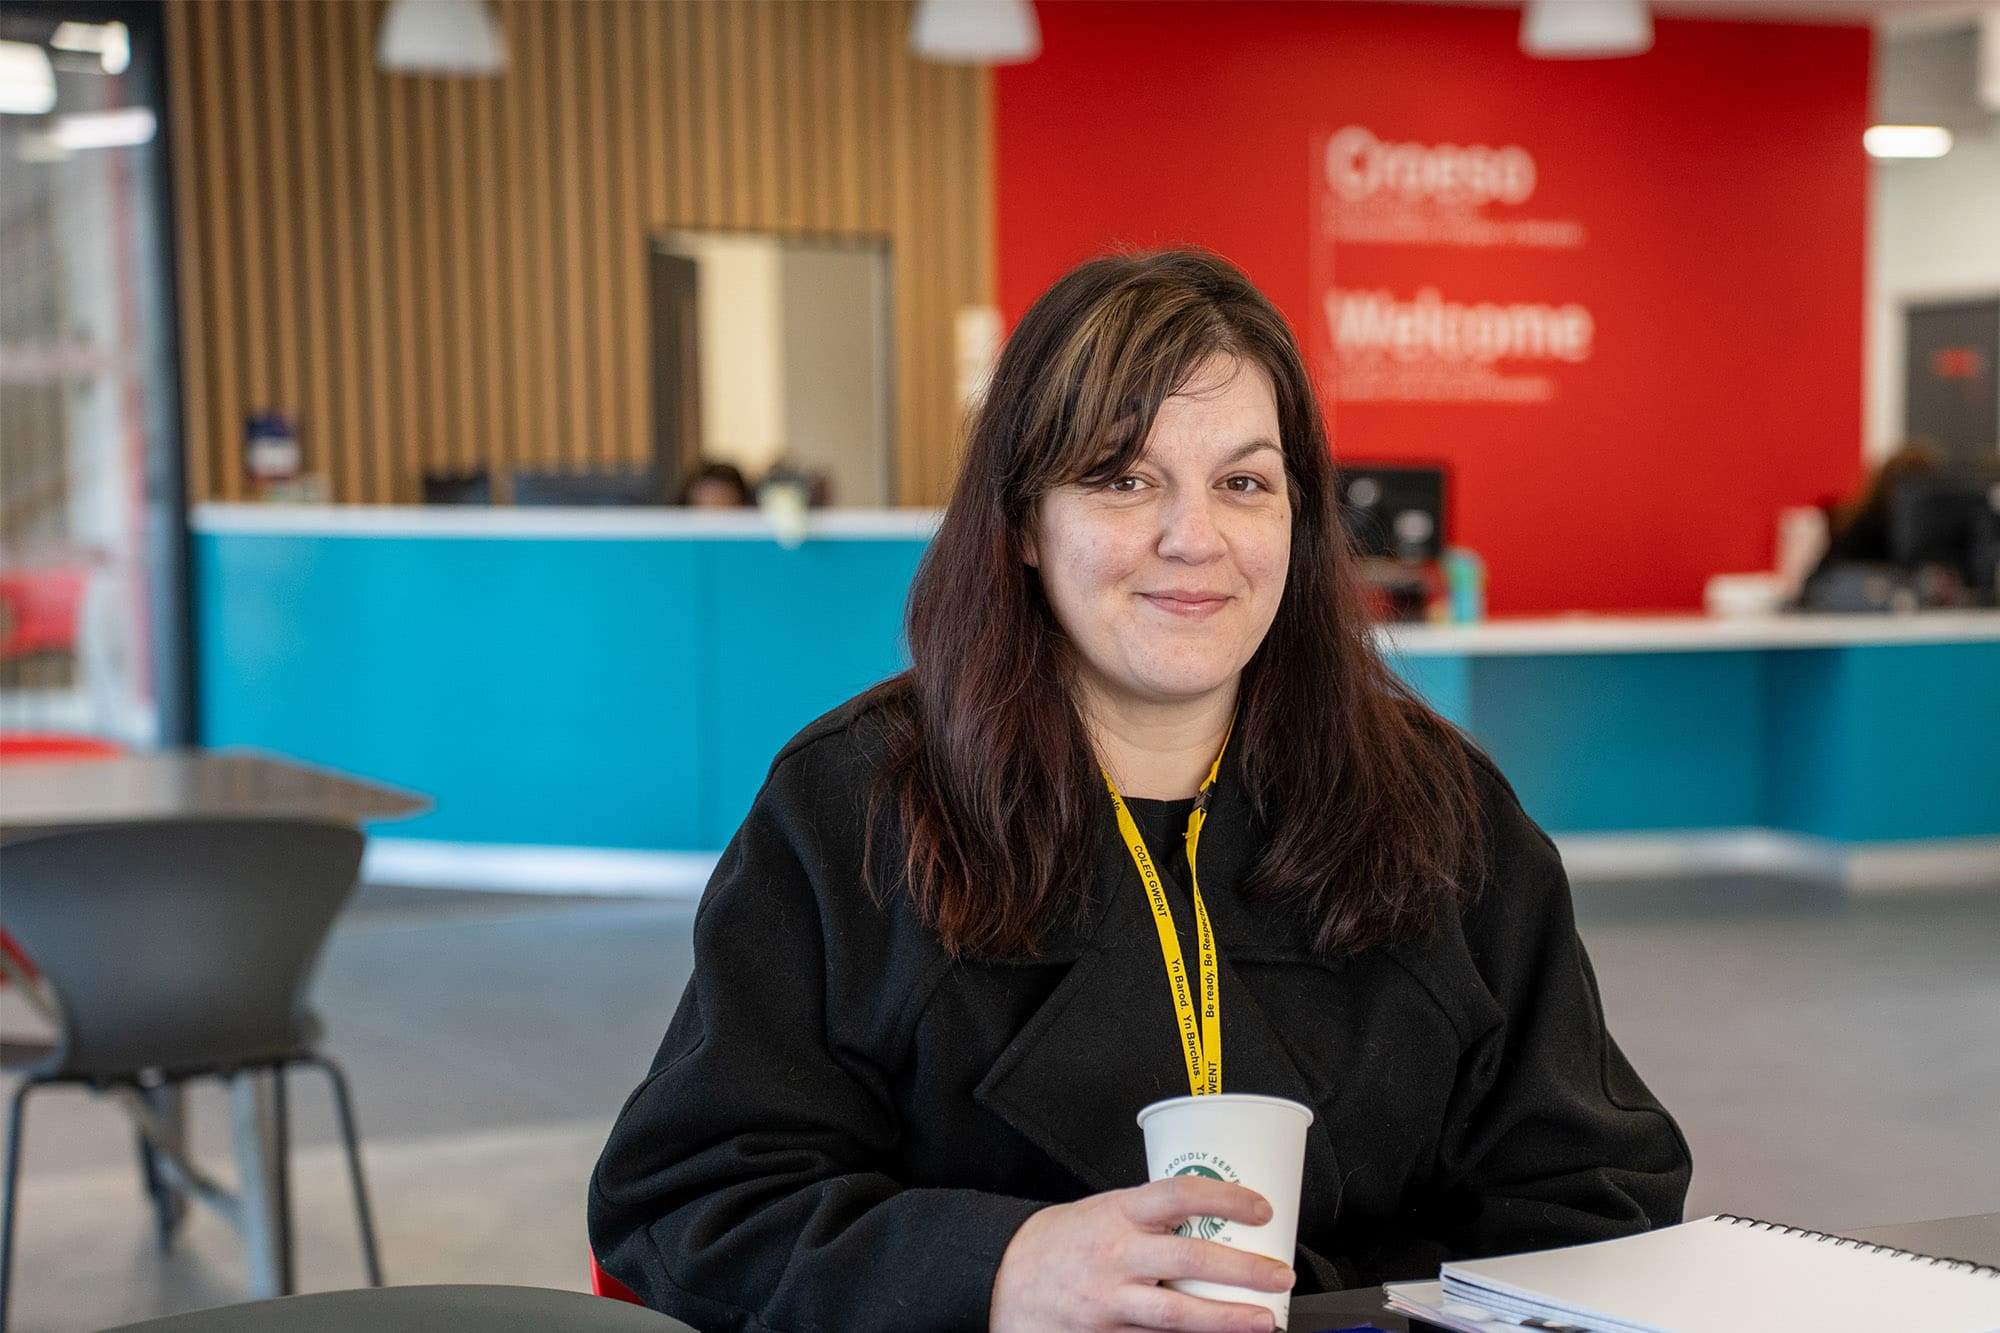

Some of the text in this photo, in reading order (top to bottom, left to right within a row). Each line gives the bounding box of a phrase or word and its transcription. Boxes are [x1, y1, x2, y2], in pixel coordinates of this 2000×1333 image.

[1327, 126, 1535, 204] Croeso
[1327, 287, 1593, 362] Welcome
[1134, 845, 1168, 917] COLEG GWENT
[1171, 958, 1181, 973] Yn
[1203, 953, 1213, 967] Be
[1174, 975, 1190, 1010] Barod.
[1205, 970, 1216, 1001] ready.
[1183, 1014, 1193, 1029] Yn
[1205, 1004, 1215, 1018] Be
[1186, 1032, 1201, 1079] Barchus.
[1164, 1152, 1208, 1177] PROUDLY
